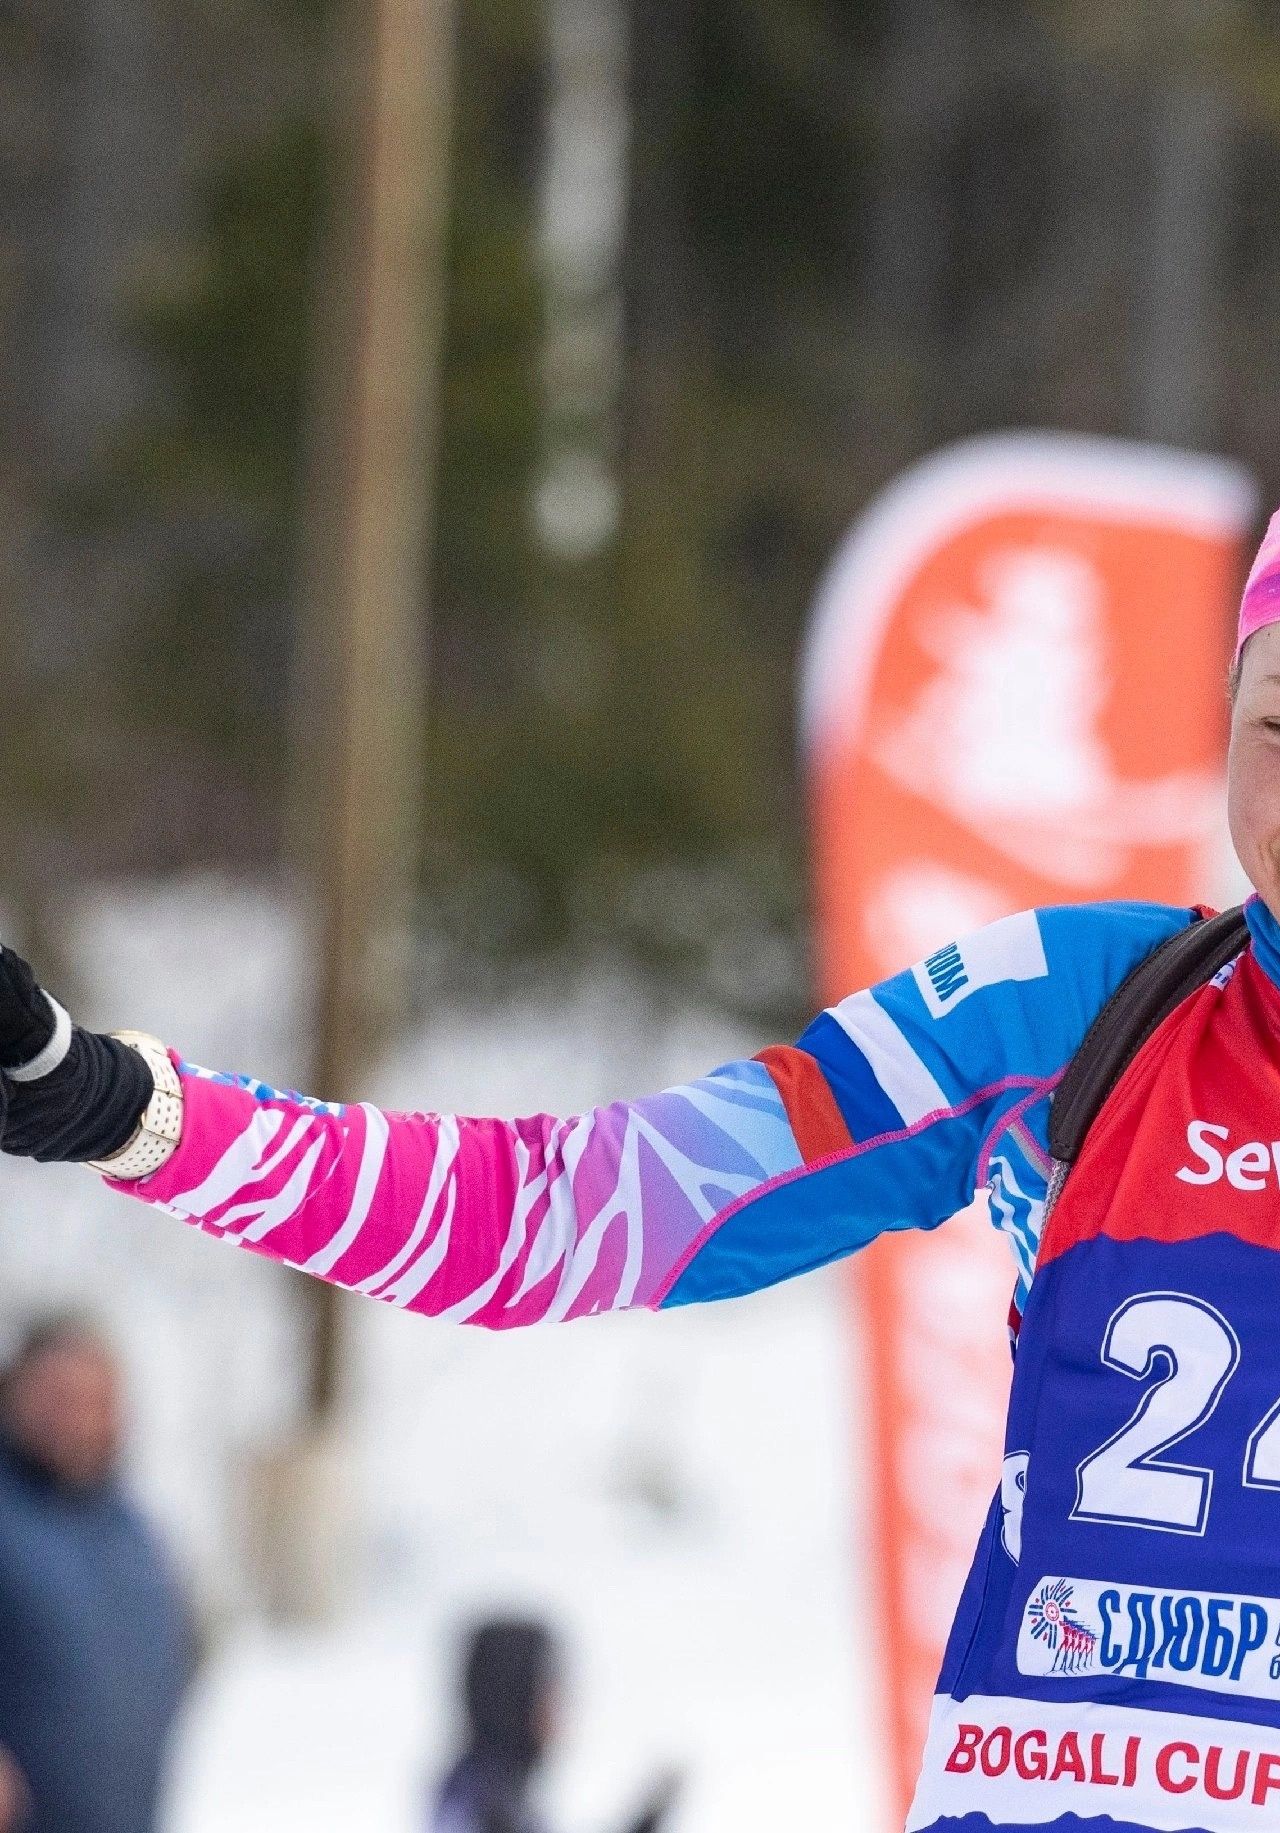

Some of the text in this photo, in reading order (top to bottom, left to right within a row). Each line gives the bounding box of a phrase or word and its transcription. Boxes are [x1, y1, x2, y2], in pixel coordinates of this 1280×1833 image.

[924, 941, 970, 1003] ROM
[1098, 1589, 1268, 1681] СДЮБР
[944, 1723, 1141, 1787] BOGALI
